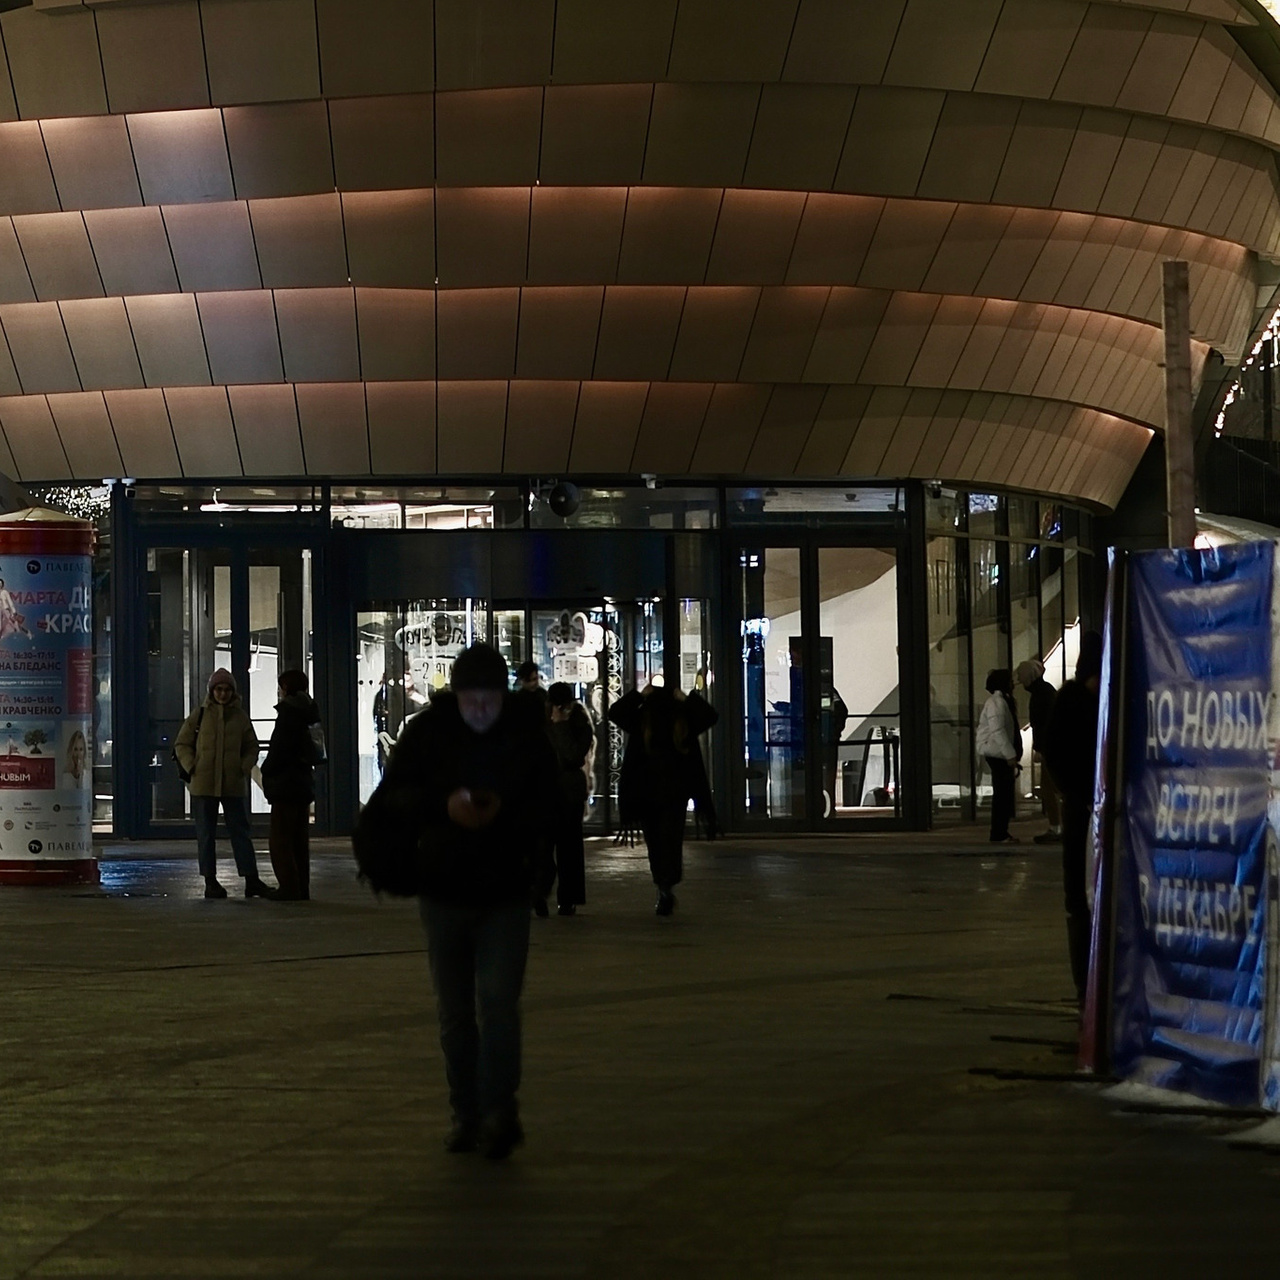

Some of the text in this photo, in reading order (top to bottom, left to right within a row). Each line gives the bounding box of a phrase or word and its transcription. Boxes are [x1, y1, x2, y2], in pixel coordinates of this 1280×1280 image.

[2, 706, 62, 715] КРАВЧЕНКО
[1146, 690, 1270, 761] ДО НОВЫХ
[1155, 784, 1240, 846] ВСТРЕЧ
[1138, 874, 1256, 947] В ДЕКАБРЕ
